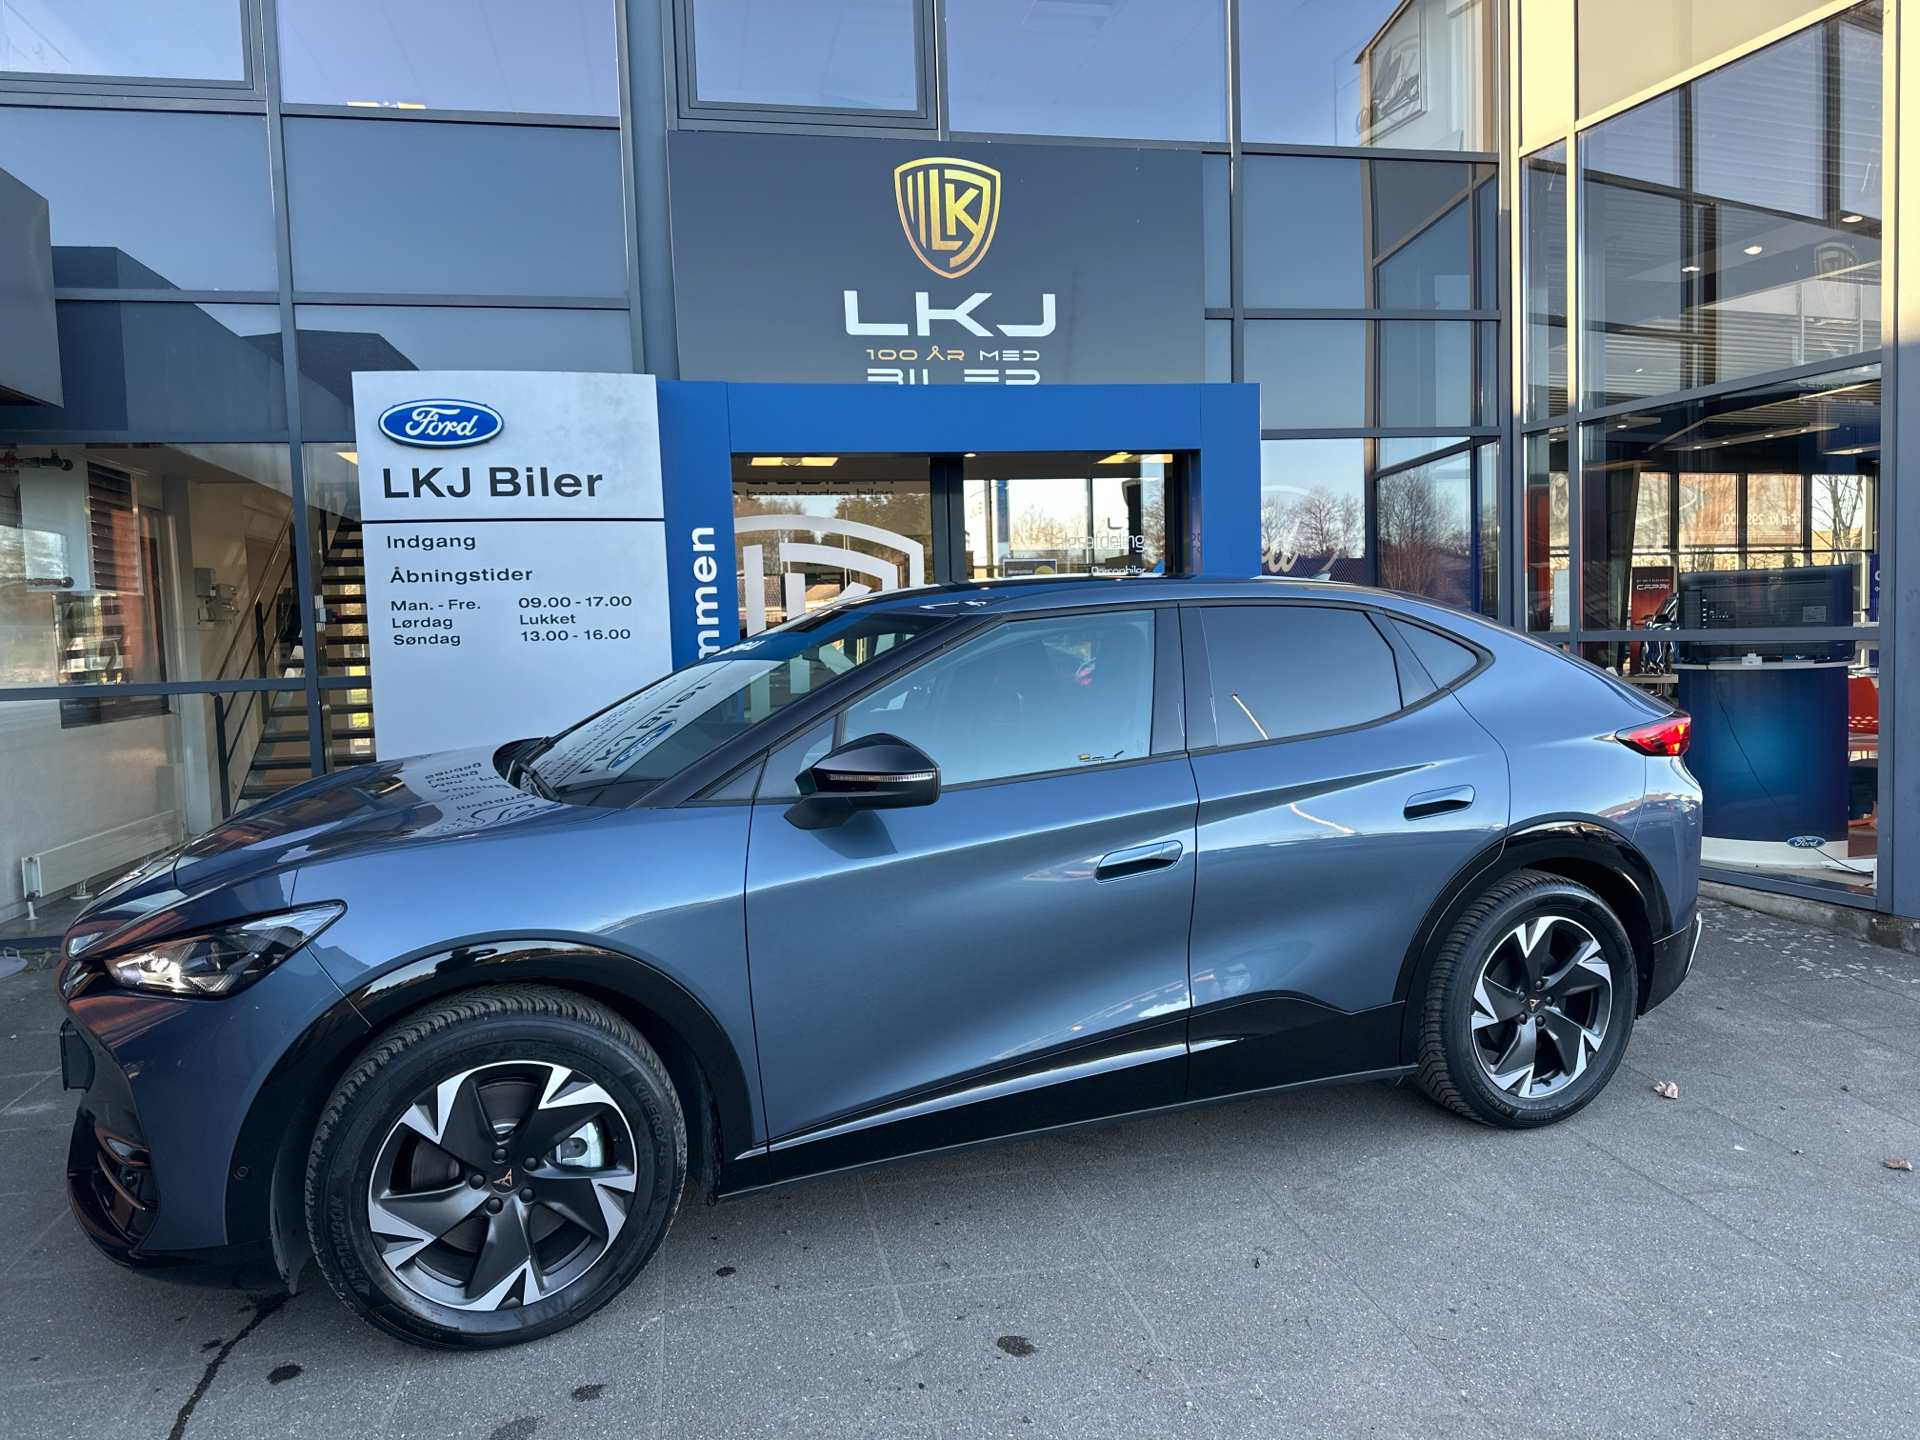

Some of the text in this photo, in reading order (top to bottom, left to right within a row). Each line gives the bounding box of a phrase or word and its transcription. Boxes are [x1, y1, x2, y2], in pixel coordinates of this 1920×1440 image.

[844, 290, 1056, 337] LKJ
[866, 345, 1040, 361] 100 ÅR MED
[405, 406, 478, 436] Ford
[383, 467, 603, 498] LKJ Biler
[387, 535, 476, 550] Indgang
[390, 566, 533, 585] Åbningstider
[391, 600, 434, 611] Man.
[448, 600, 481, 610] Fre.
[518, 597, 572, 608] 09.00
[585, 596, 632, 607] 17.00
[392, 616, 453, 630] Lørdag
[520, 613, 576, 625] Lukket
[394, 634, 460, 646] Søndag
[521, 630, 569, 642] 13.00
[584, 629, 631, 640] 16.00
[1794, 838, 1819, 847] Ford
